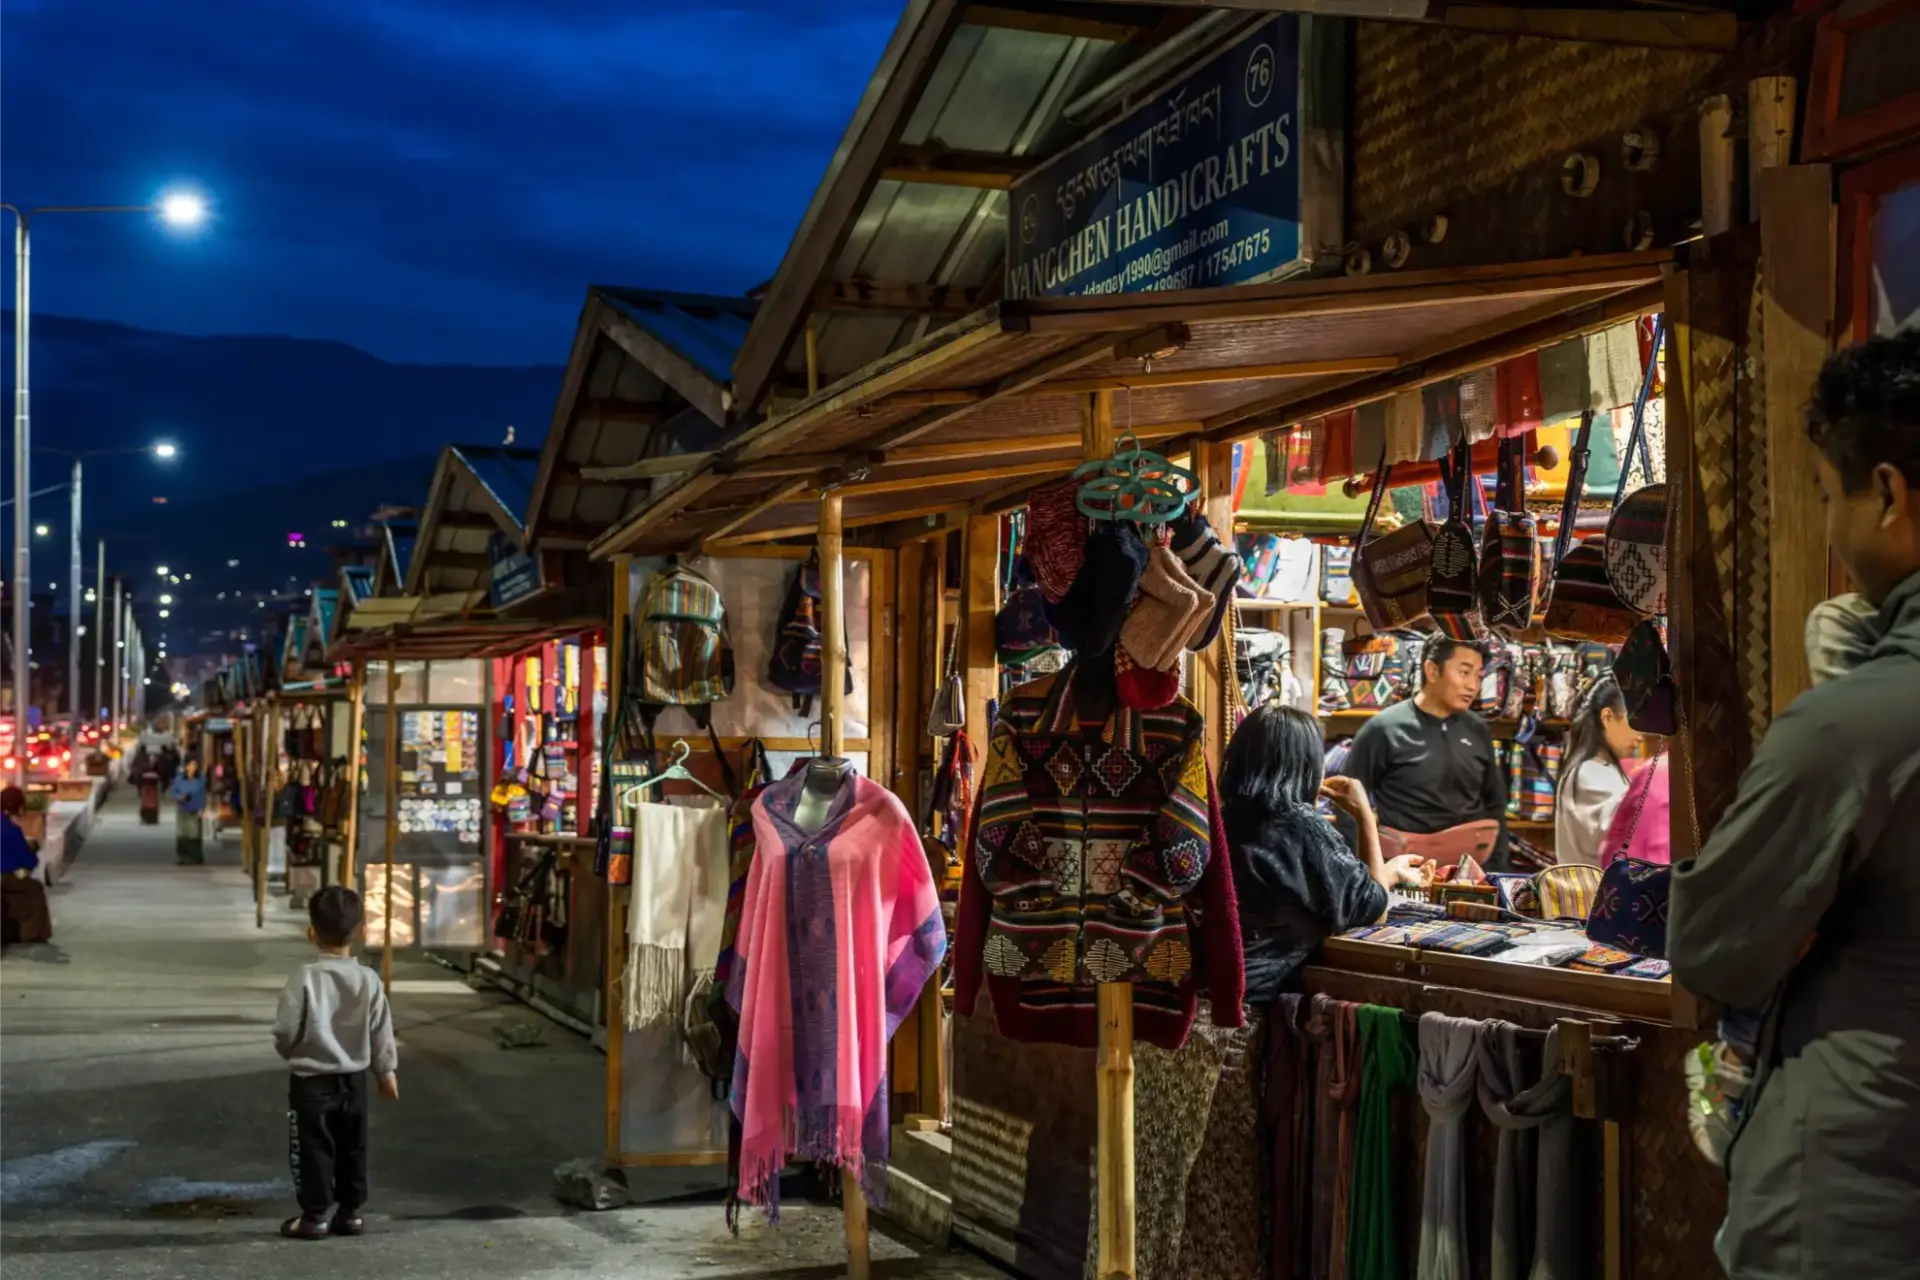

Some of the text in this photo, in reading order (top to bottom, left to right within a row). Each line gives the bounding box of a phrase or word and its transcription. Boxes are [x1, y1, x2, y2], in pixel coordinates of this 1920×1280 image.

[1250, 58, 1270, 93] 76
[1010, 112, 1291, 300] YANGCHEN HANDICRAFTS
[1206, 228, 1270, 279] 17547675
